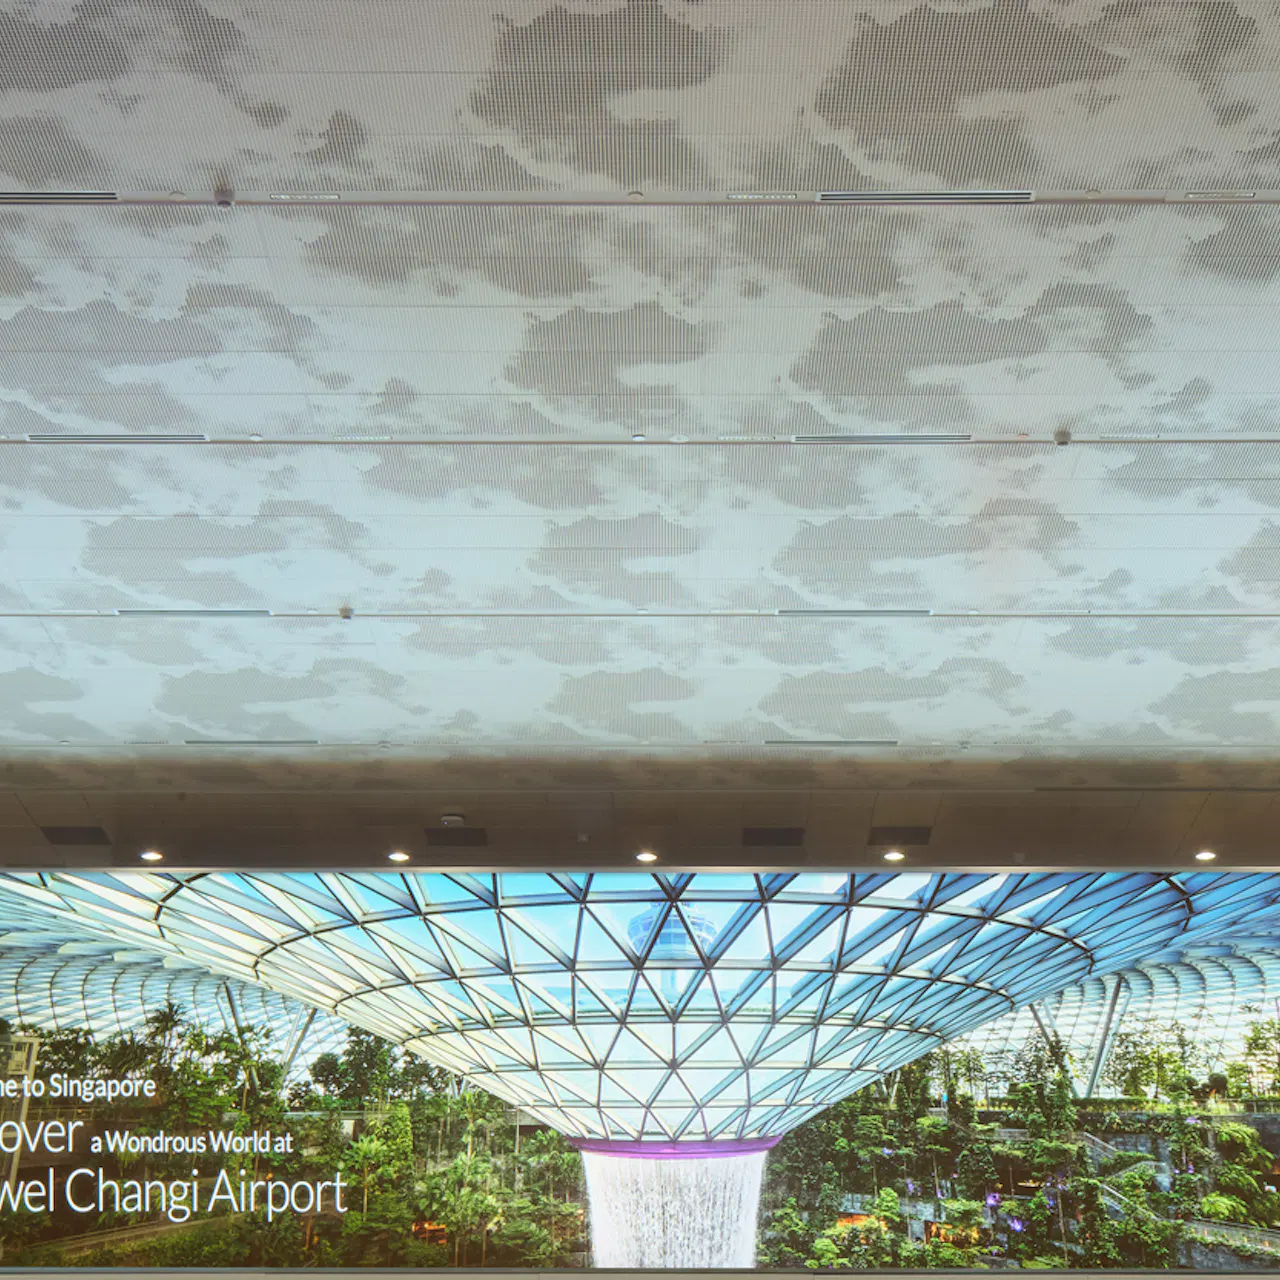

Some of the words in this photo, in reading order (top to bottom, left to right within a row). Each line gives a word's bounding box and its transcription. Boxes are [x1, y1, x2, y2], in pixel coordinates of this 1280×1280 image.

[22, 1075, 45, 1097] to
[49, 1073, 157, 1102] Singapore
[91, 1137, 102, 1153] a
[104, 1130, 207, 1153] Wondrous
[209, 1130, 271, 1153] World
[274, 1132, 294, 1153] at
[65, 1167, 199, 1223] Changi
[207, 1168, 349, 1223] Airport
